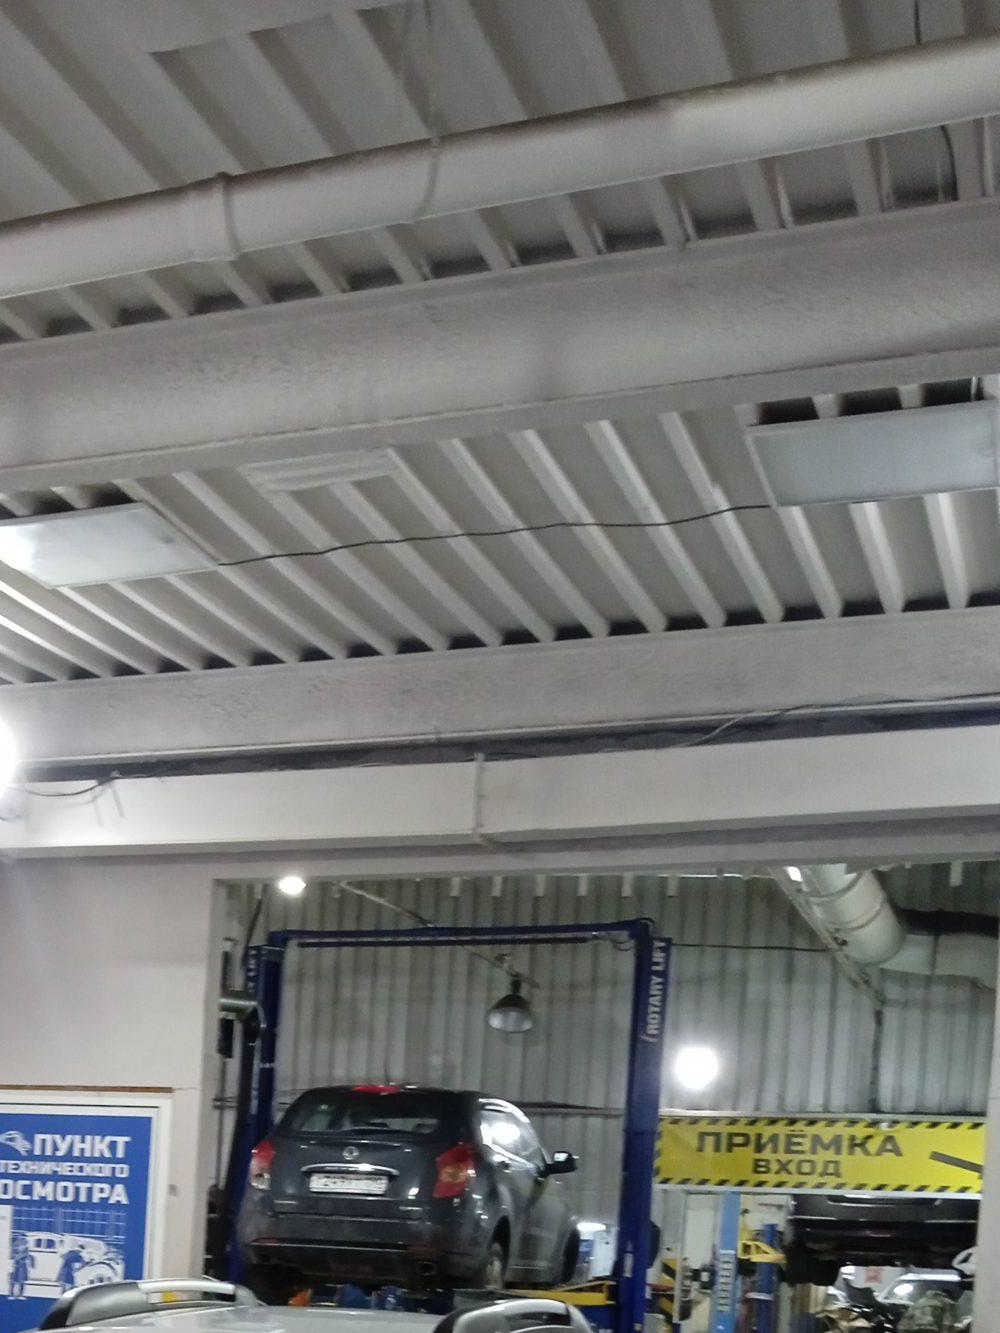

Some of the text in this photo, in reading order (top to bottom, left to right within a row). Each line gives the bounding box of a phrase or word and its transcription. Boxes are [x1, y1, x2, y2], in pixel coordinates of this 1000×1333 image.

[33, 1133, 132, 1158] ПУНКТ
[696, 1129, 904, 1157] ПРИЁМКА
[752, 1159, 843, 1179] ВХОД
